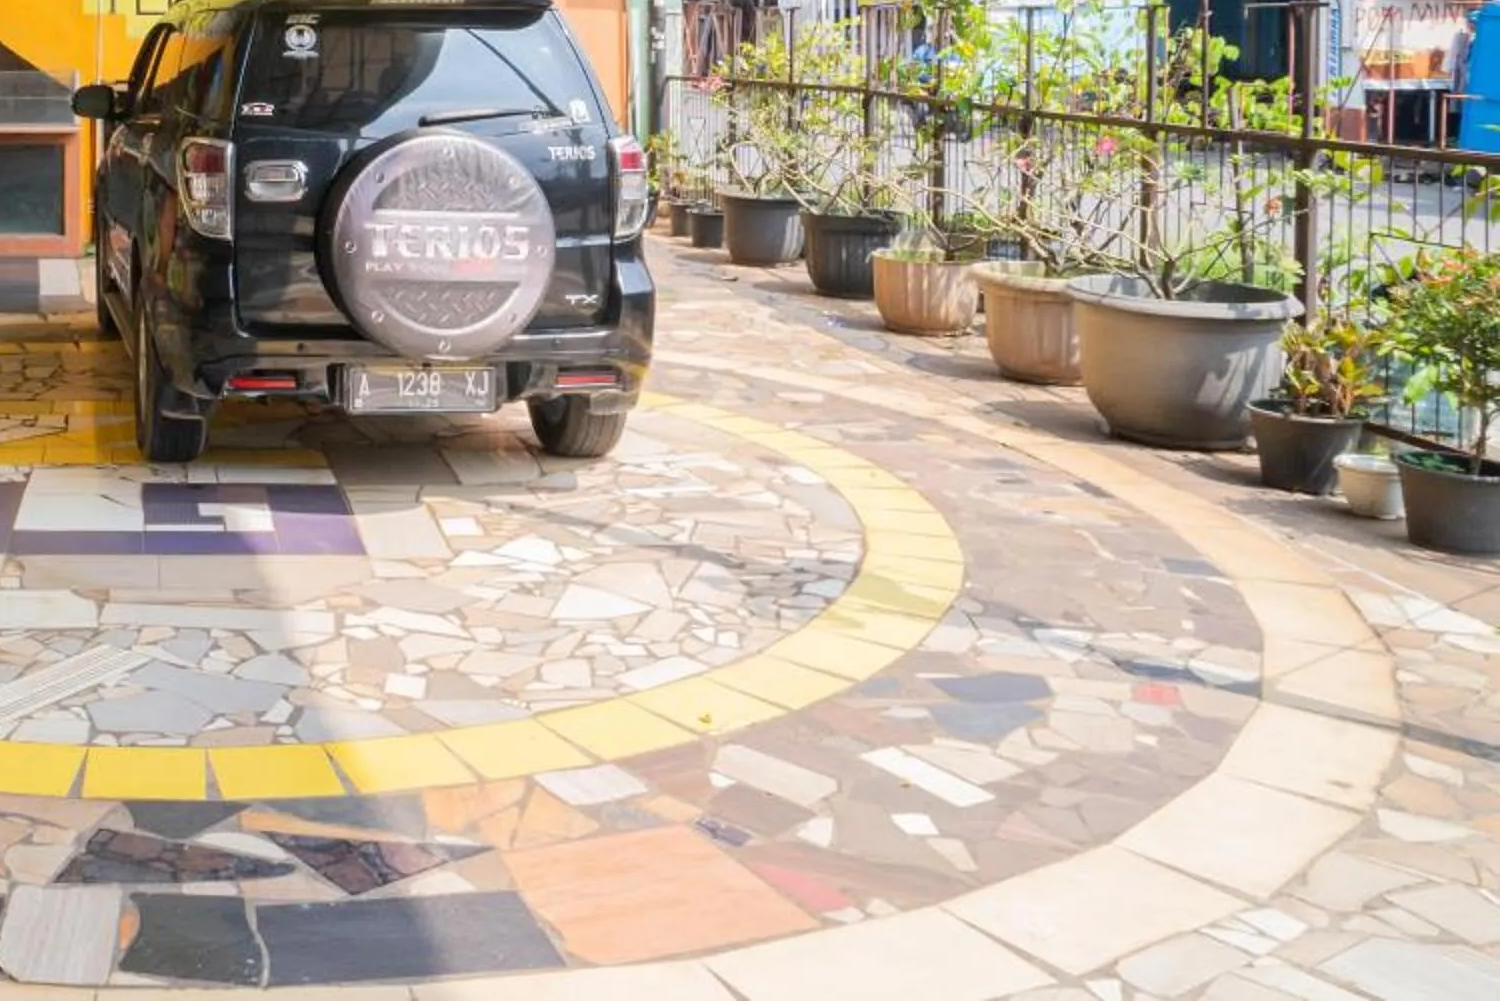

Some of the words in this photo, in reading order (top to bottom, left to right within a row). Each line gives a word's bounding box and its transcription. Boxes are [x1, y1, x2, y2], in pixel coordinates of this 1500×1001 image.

[548, 146, 596, 160] TERIOS
[364, 222, 529, 260] TERIOS
[358, 372, 370, 397] A
[396, 371, 441, 397] 1238
[465, 370, 490, 396] XJ
